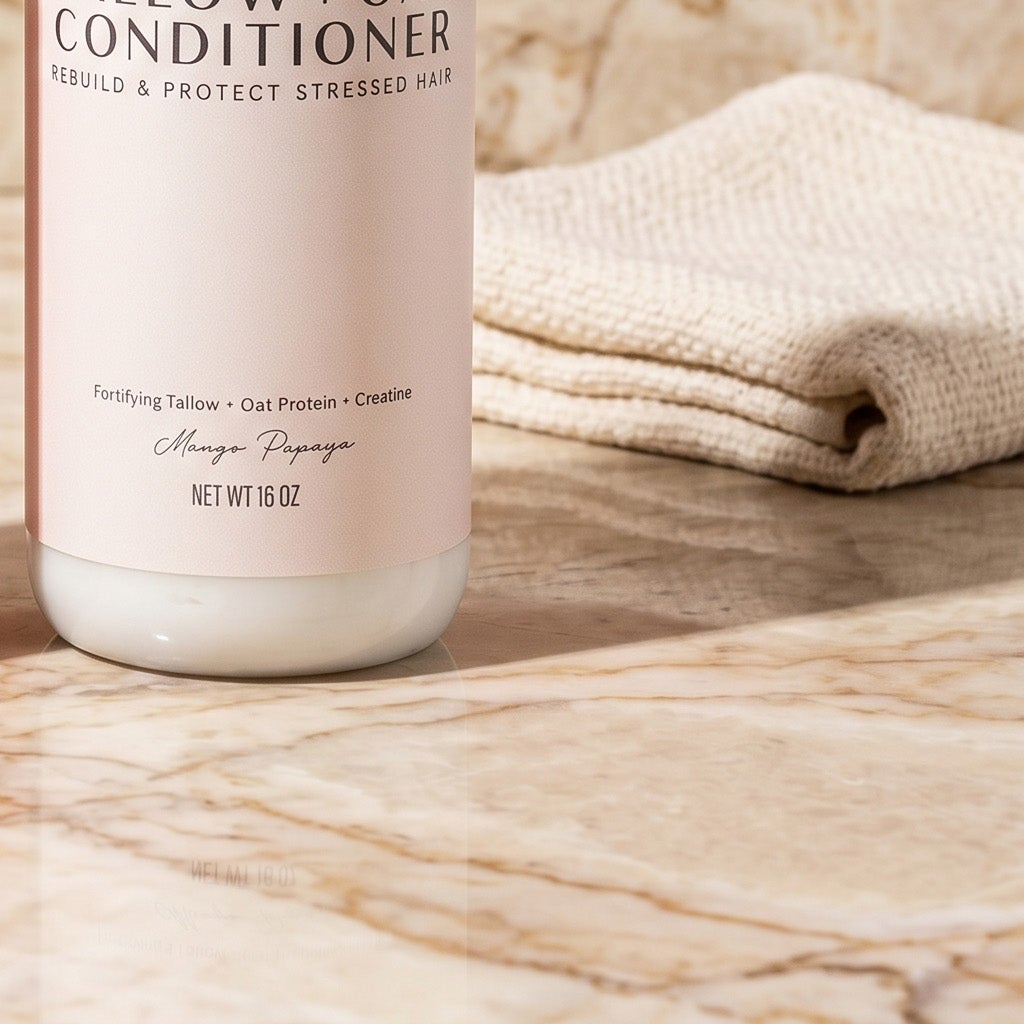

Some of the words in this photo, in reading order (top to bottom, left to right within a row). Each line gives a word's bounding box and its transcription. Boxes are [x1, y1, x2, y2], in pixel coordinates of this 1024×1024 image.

[55, 8, 450, 67] CONDITIONER
[51, 64, 125, 94] REBUILD
[137, 79, 150, 97] &
[163, 81, 281, 102] PROTECT
[295, 75, 407, 101] STRESSED
[416, 67, 453, 91] HAIR
[94, 384, 163, 412] Fortifying
[166, 394, 220, 412] Tallow
[226, 400, 234, 409] +
[240, 397, 273, 413] Oat
[278, 394, 337, 412] Protein
[342, 396, 350, 405] +
[354, 386, 413, 407] Creatine
[154, 429, 248, 466] Mango
[256, 429, 356, 466] Papaya
[192, 483, 223, 507] NET
[226, 484, 254, 508] WT
[256, 484, 275, 508] 16
[279, 484, 301, 508] OZ
